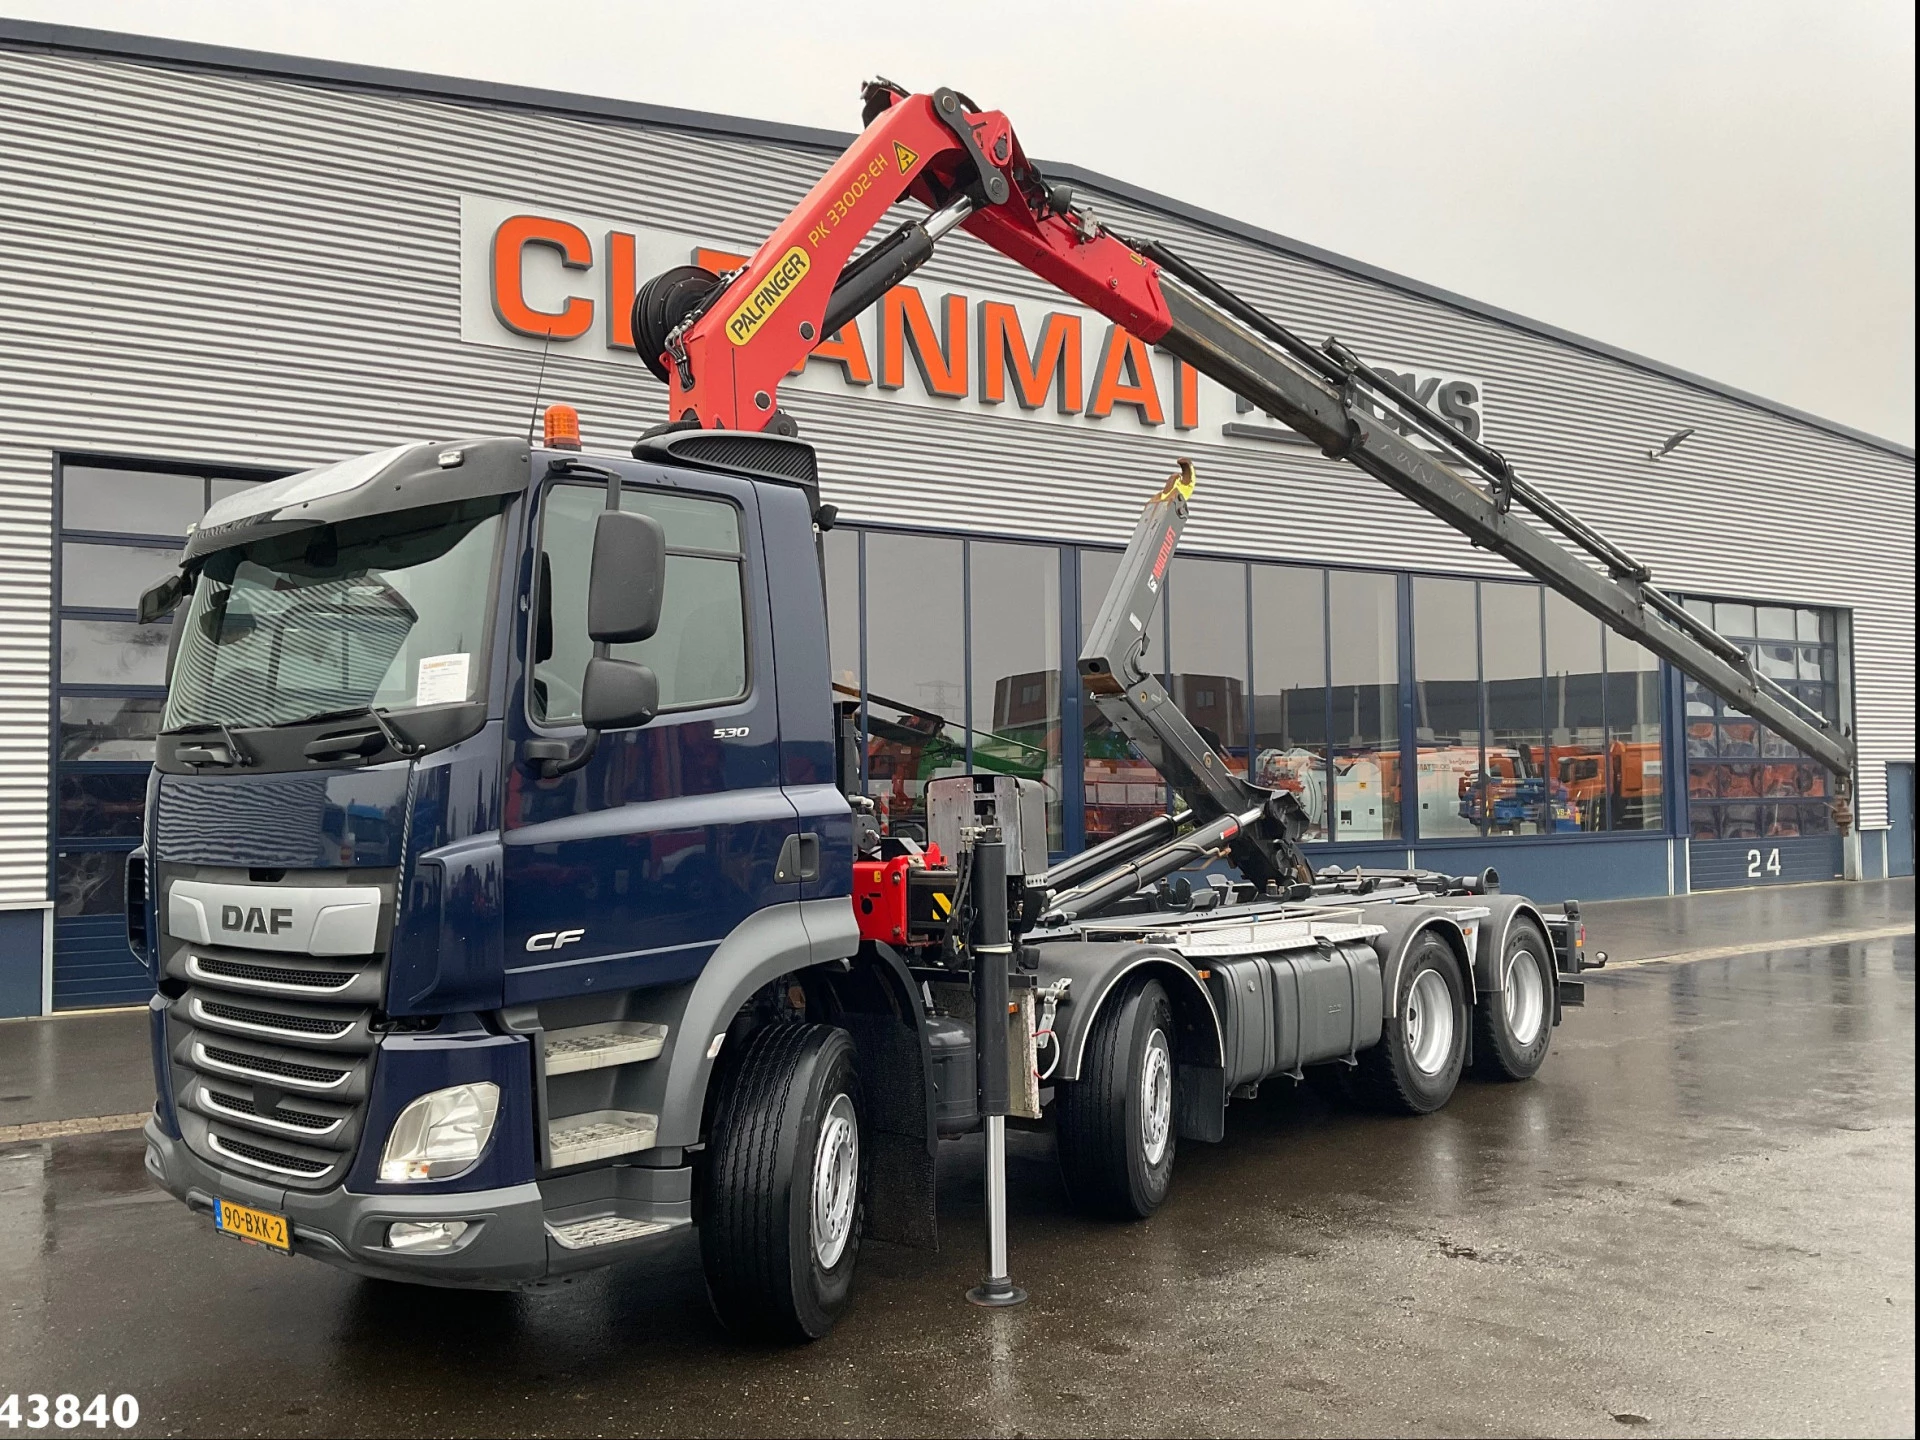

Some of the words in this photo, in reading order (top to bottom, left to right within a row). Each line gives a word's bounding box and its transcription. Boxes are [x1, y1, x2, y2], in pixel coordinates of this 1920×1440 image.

[807, 219, 829, 247] PK
[729, 251, 808, 342] PALFINGER
[713, 726, 749, 739] 530
[1747, 848, 1782, 878] 24
[221, 904, 293, 935] DAF
[525, 928, 586, 952] CF
[224, 1206, 284, 1243] 90-BXK-2
